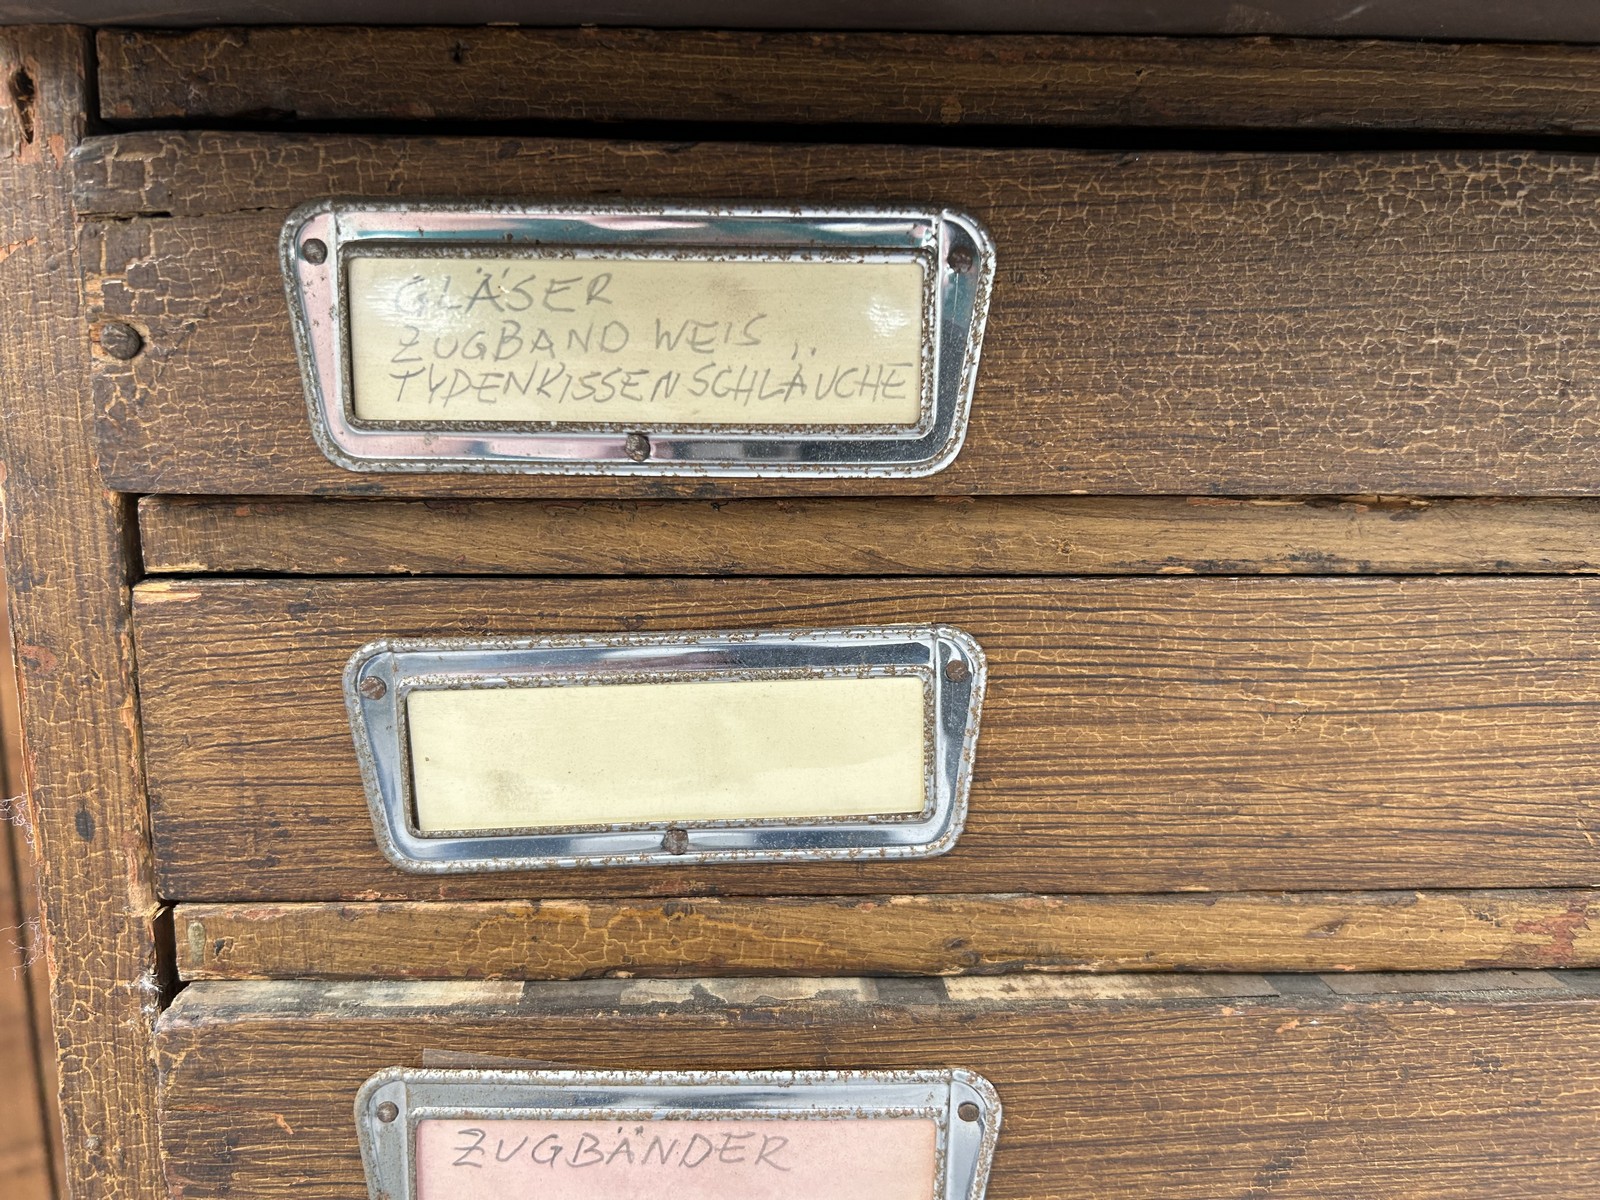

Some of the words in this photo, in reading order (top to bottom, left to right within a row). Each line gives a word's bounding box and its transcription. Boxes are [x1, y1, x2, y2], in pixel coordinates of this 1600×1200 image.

[394, 267, 613, 313] GLÄSER
[390, 319, 630, 364] ZUGBAND
[655, 313, 765, 355] WEIS
[452, 1126, 792, 1171] ZUGBÄNDER
